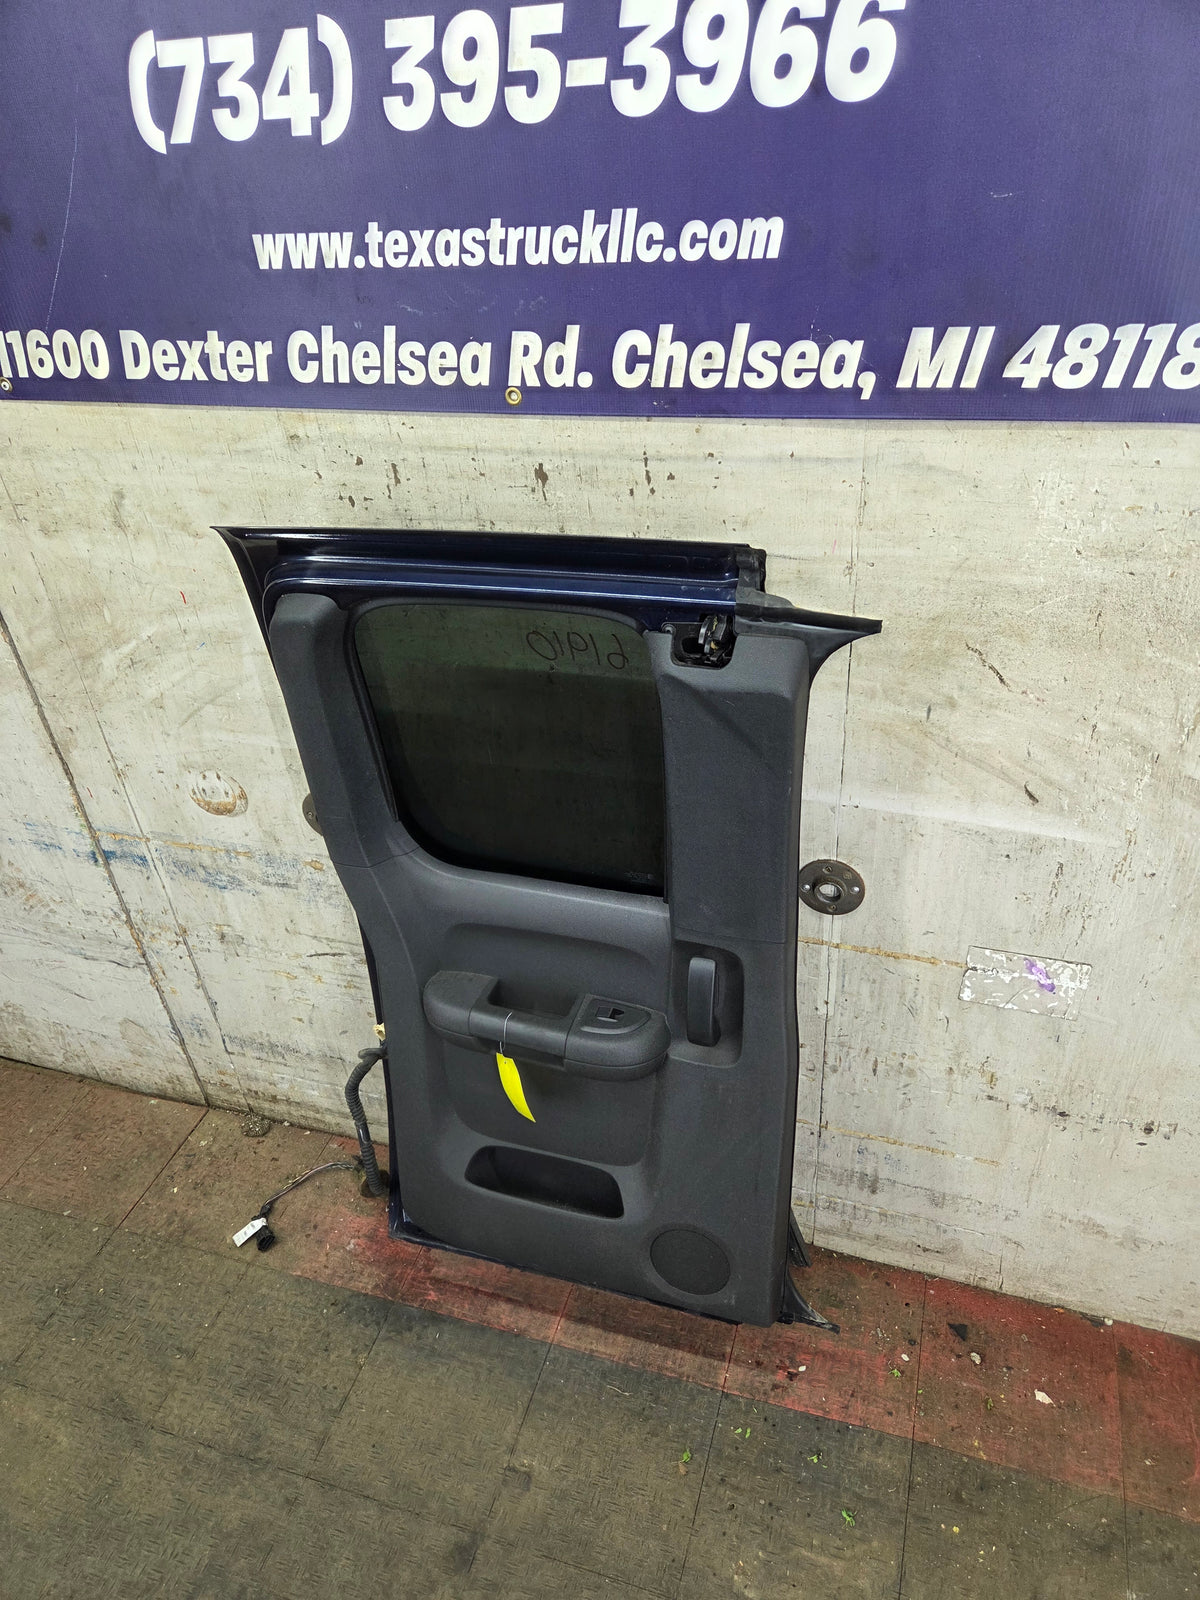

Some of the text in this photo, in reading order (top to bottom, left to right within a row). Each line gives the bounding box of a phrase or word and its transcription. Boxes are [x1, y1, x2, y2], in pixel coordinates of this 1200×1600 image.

[128, 0, 907, 155] (734) 395-3966
[251, 207, 785, 270] www.texastruckllc.com
[118, 329, 273, 383] Dexter
[287, 325, 492, 387] Chelsea
[507, 324, 593, 389] Rd.
[611, 322, 877, 400] Chelsea,
[895, 325, 996, 389] MI
[1002, 322, 1200, 390] 48118
